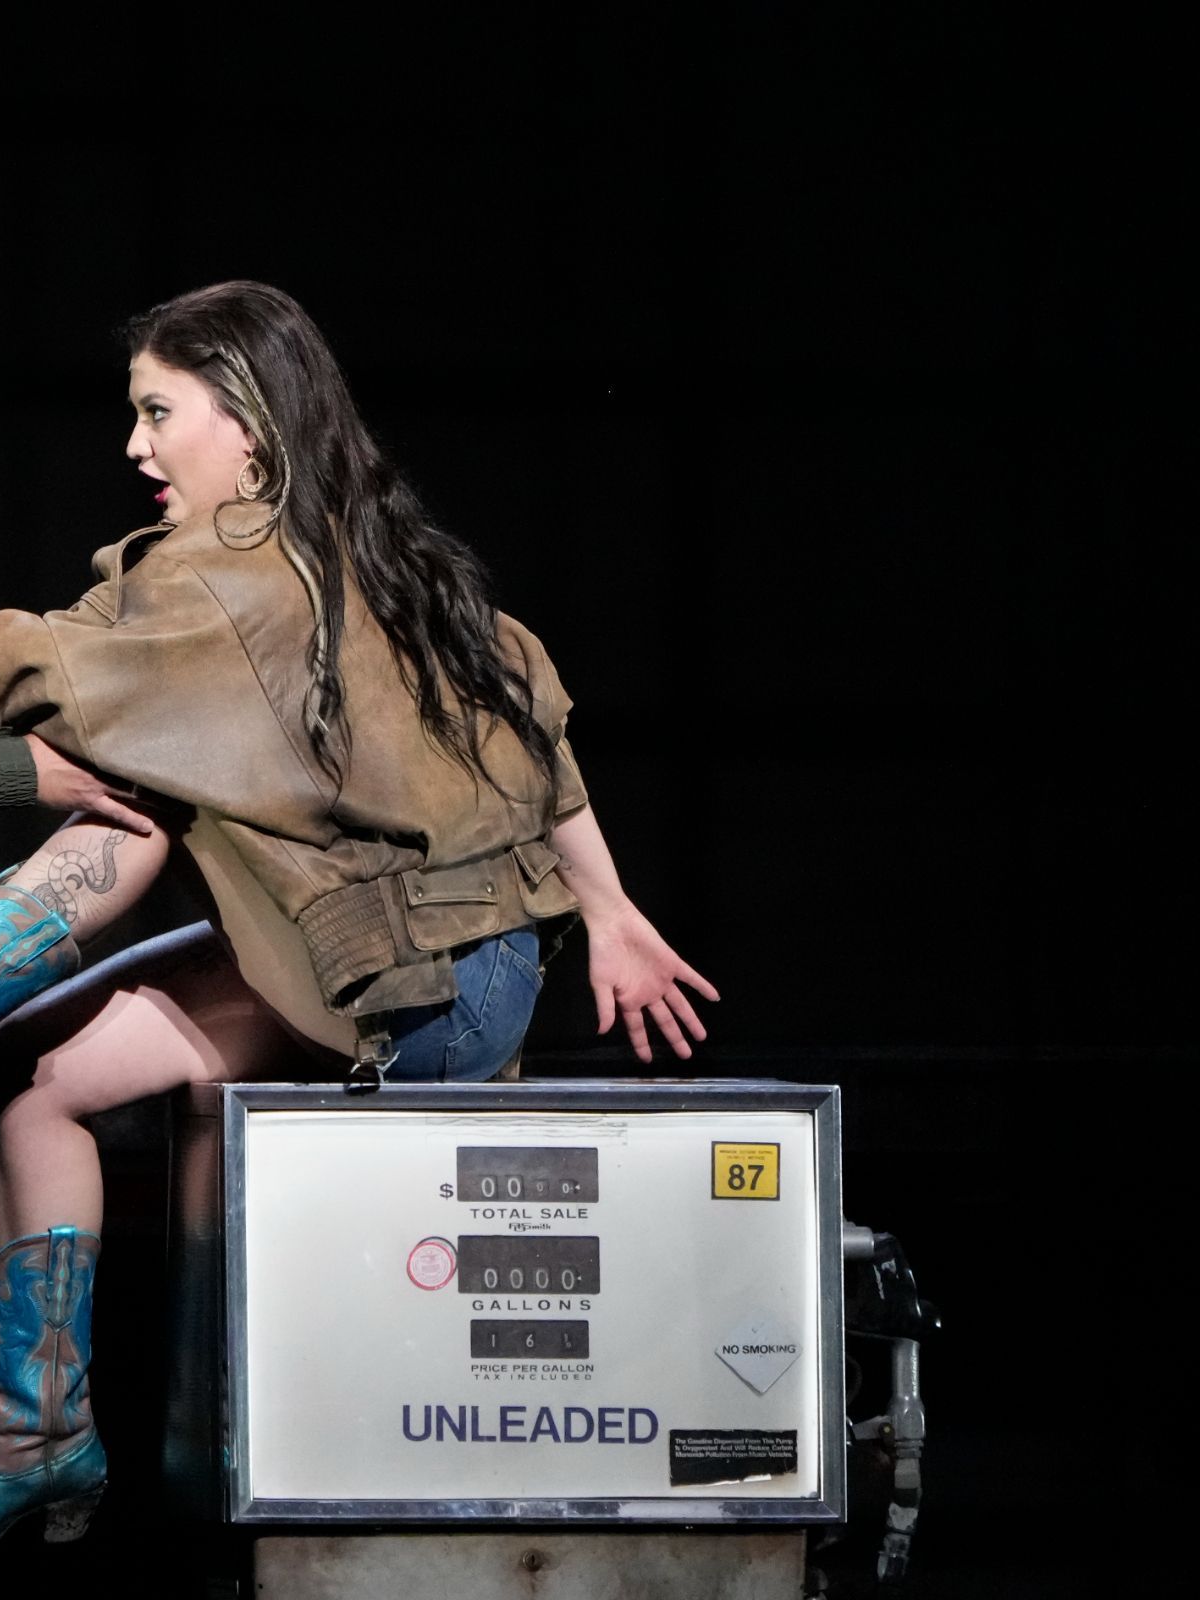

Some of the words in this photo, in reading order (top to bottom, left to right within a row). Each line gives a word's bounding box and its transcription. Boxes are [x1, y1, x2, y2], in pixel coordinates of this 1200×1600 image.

[727, 1164, 765, 1191] 87
[439, 1183, 454, 1200] $
[469, 1208, 533, 1220] TOTAL
[540, 1208, 589, 1220] SALE
[472, 1299, 592, 1311] GALLONS
[722, 1344, 740, 1355] NO
[742, 1344, 796, 1355] SMOKING
[471, 1364, 508, 1373] PRICE
[512, 1364, 538, 1373] PER
[542, 1364, 594, 1373] GALLON
[402, 1405, 659, 1444] UNLEADED
